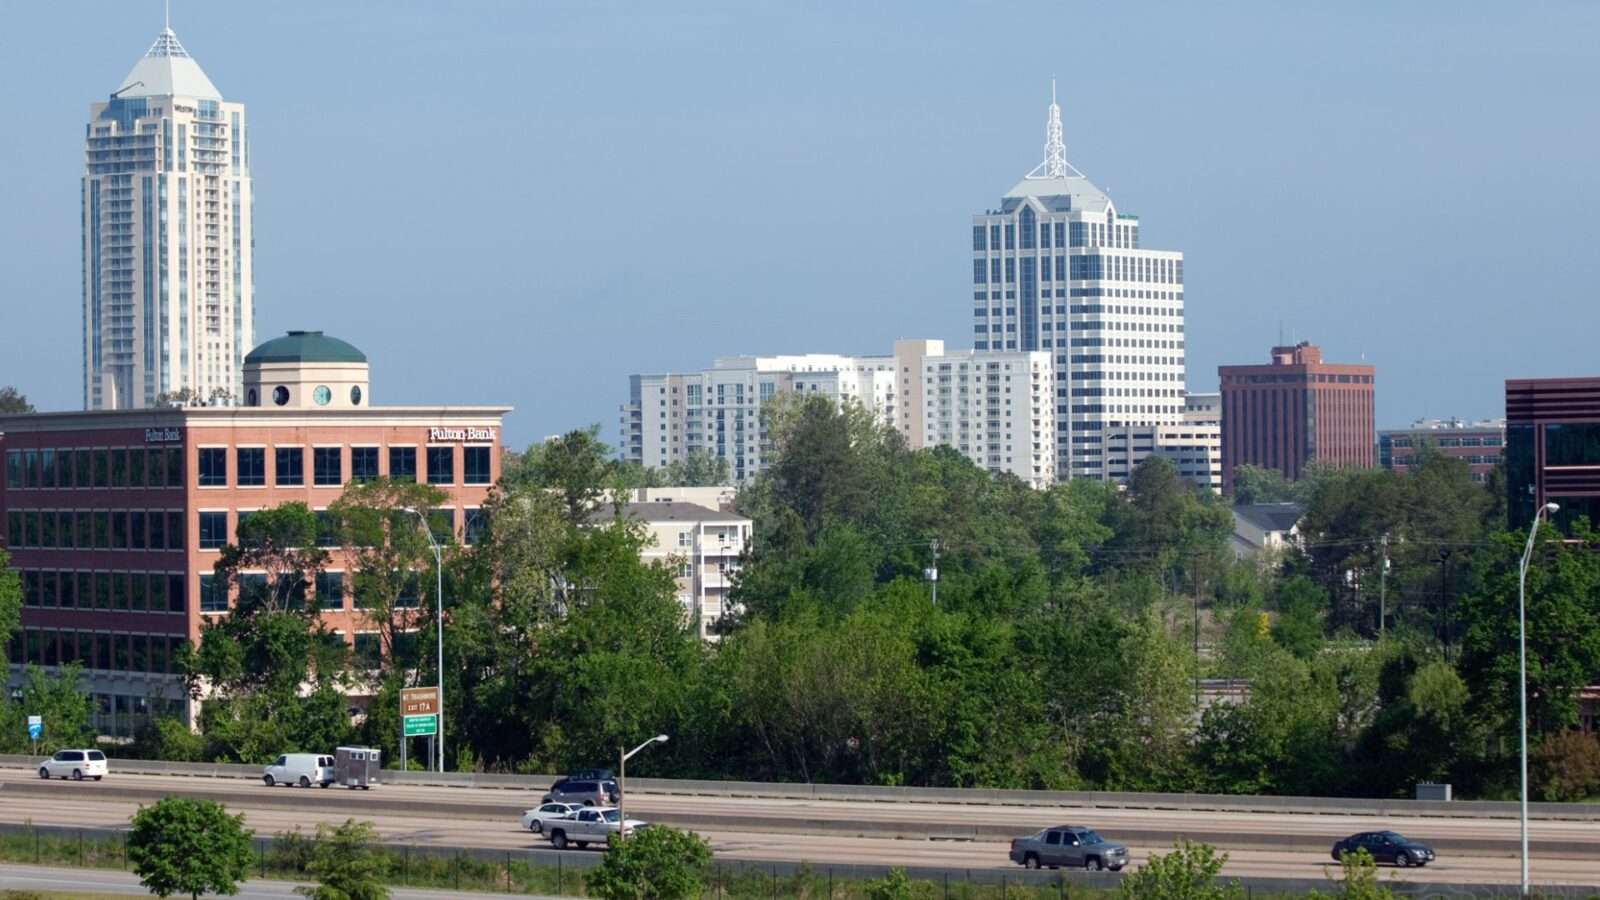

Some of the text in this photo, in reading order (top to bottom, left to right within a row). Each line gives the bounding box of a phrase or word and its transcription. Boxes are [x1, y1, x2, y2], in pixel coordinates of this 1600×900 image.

[145, 428, 181, 441] Fulton Bank
[430, 427, 496, 440] Fulton Bank
[419, 702, 431, 712] 17A
